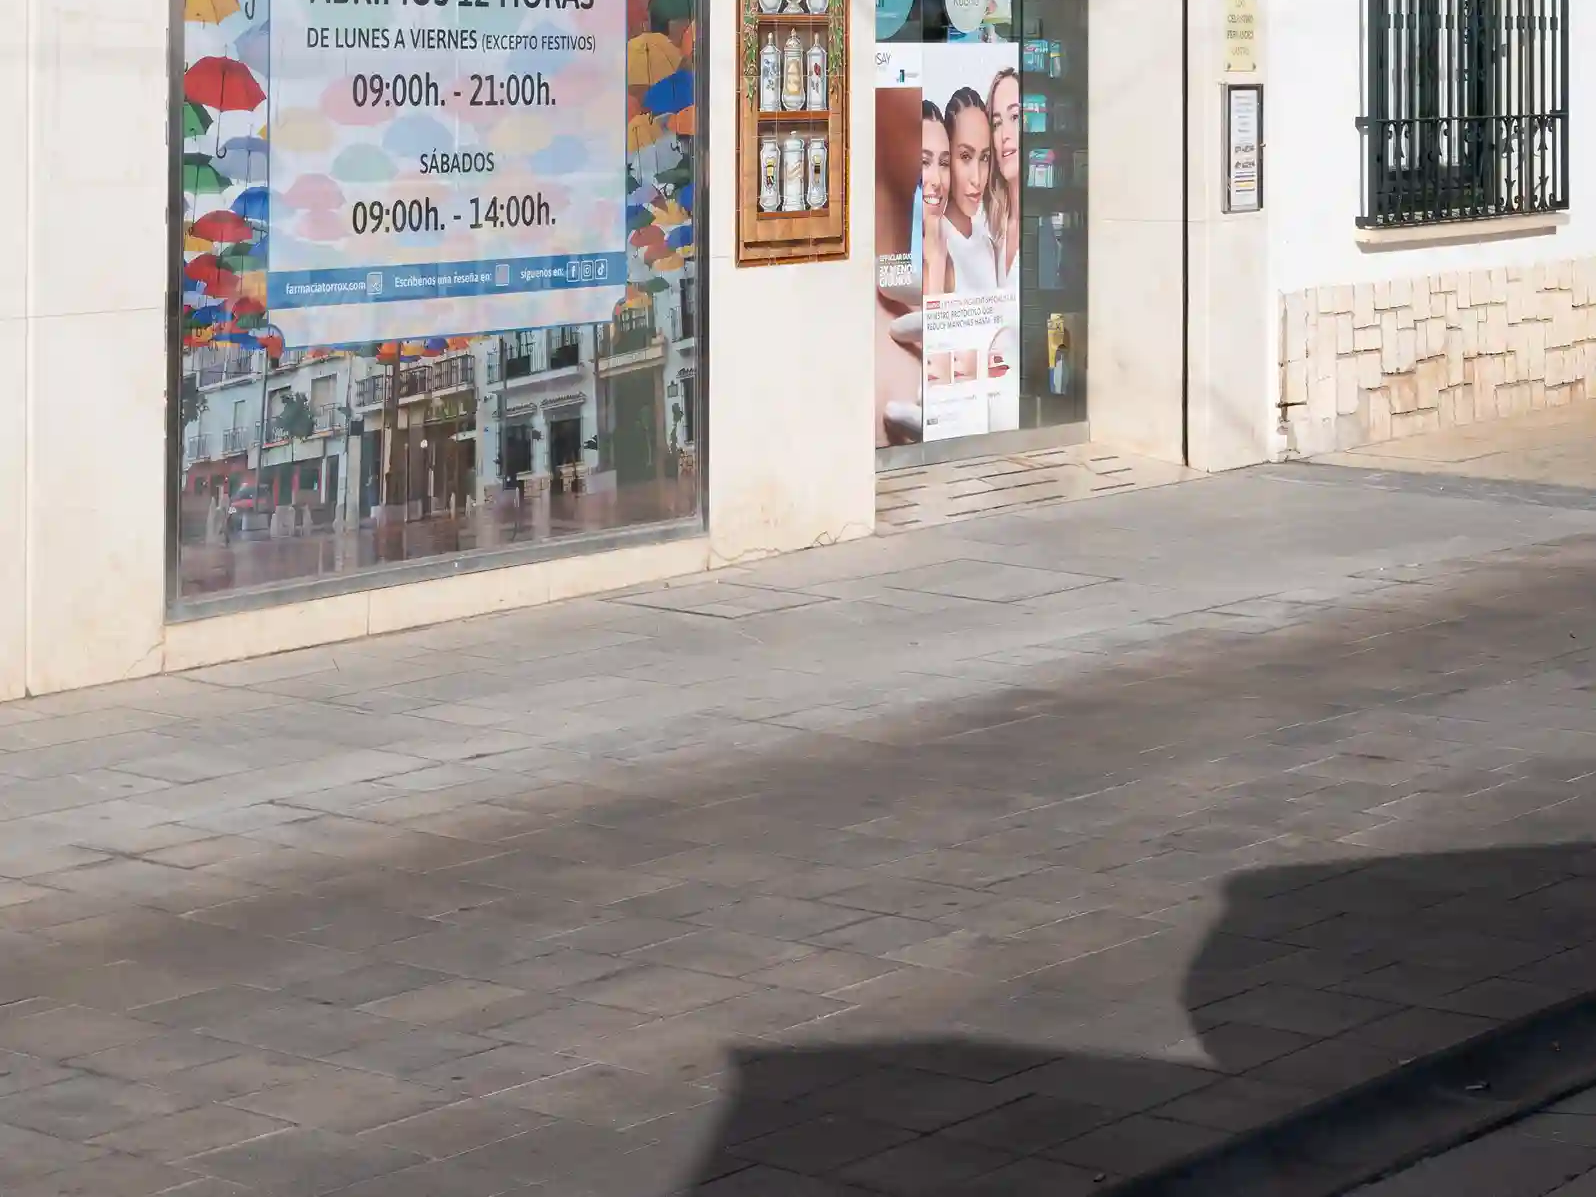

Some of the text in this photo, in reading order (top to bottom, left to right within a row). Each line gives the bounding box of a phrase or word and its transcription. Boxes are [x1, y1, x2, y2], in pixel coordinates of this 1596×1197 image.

[307, 27, 596, 53] DE LUNES A VIERNES (EXCEPTO FESTIVOS)
[352, 72, 446, 107] 09:00h.
[469, 72, 556, 107] 21:00h.
[419, 148, 495, 174] SÁBADOS
[352, 196, 446, 234] 09:00h.
[469, 192, 556, 230] 14:00h.
[286, 281, 366, 295] farmaciatorrox.com
